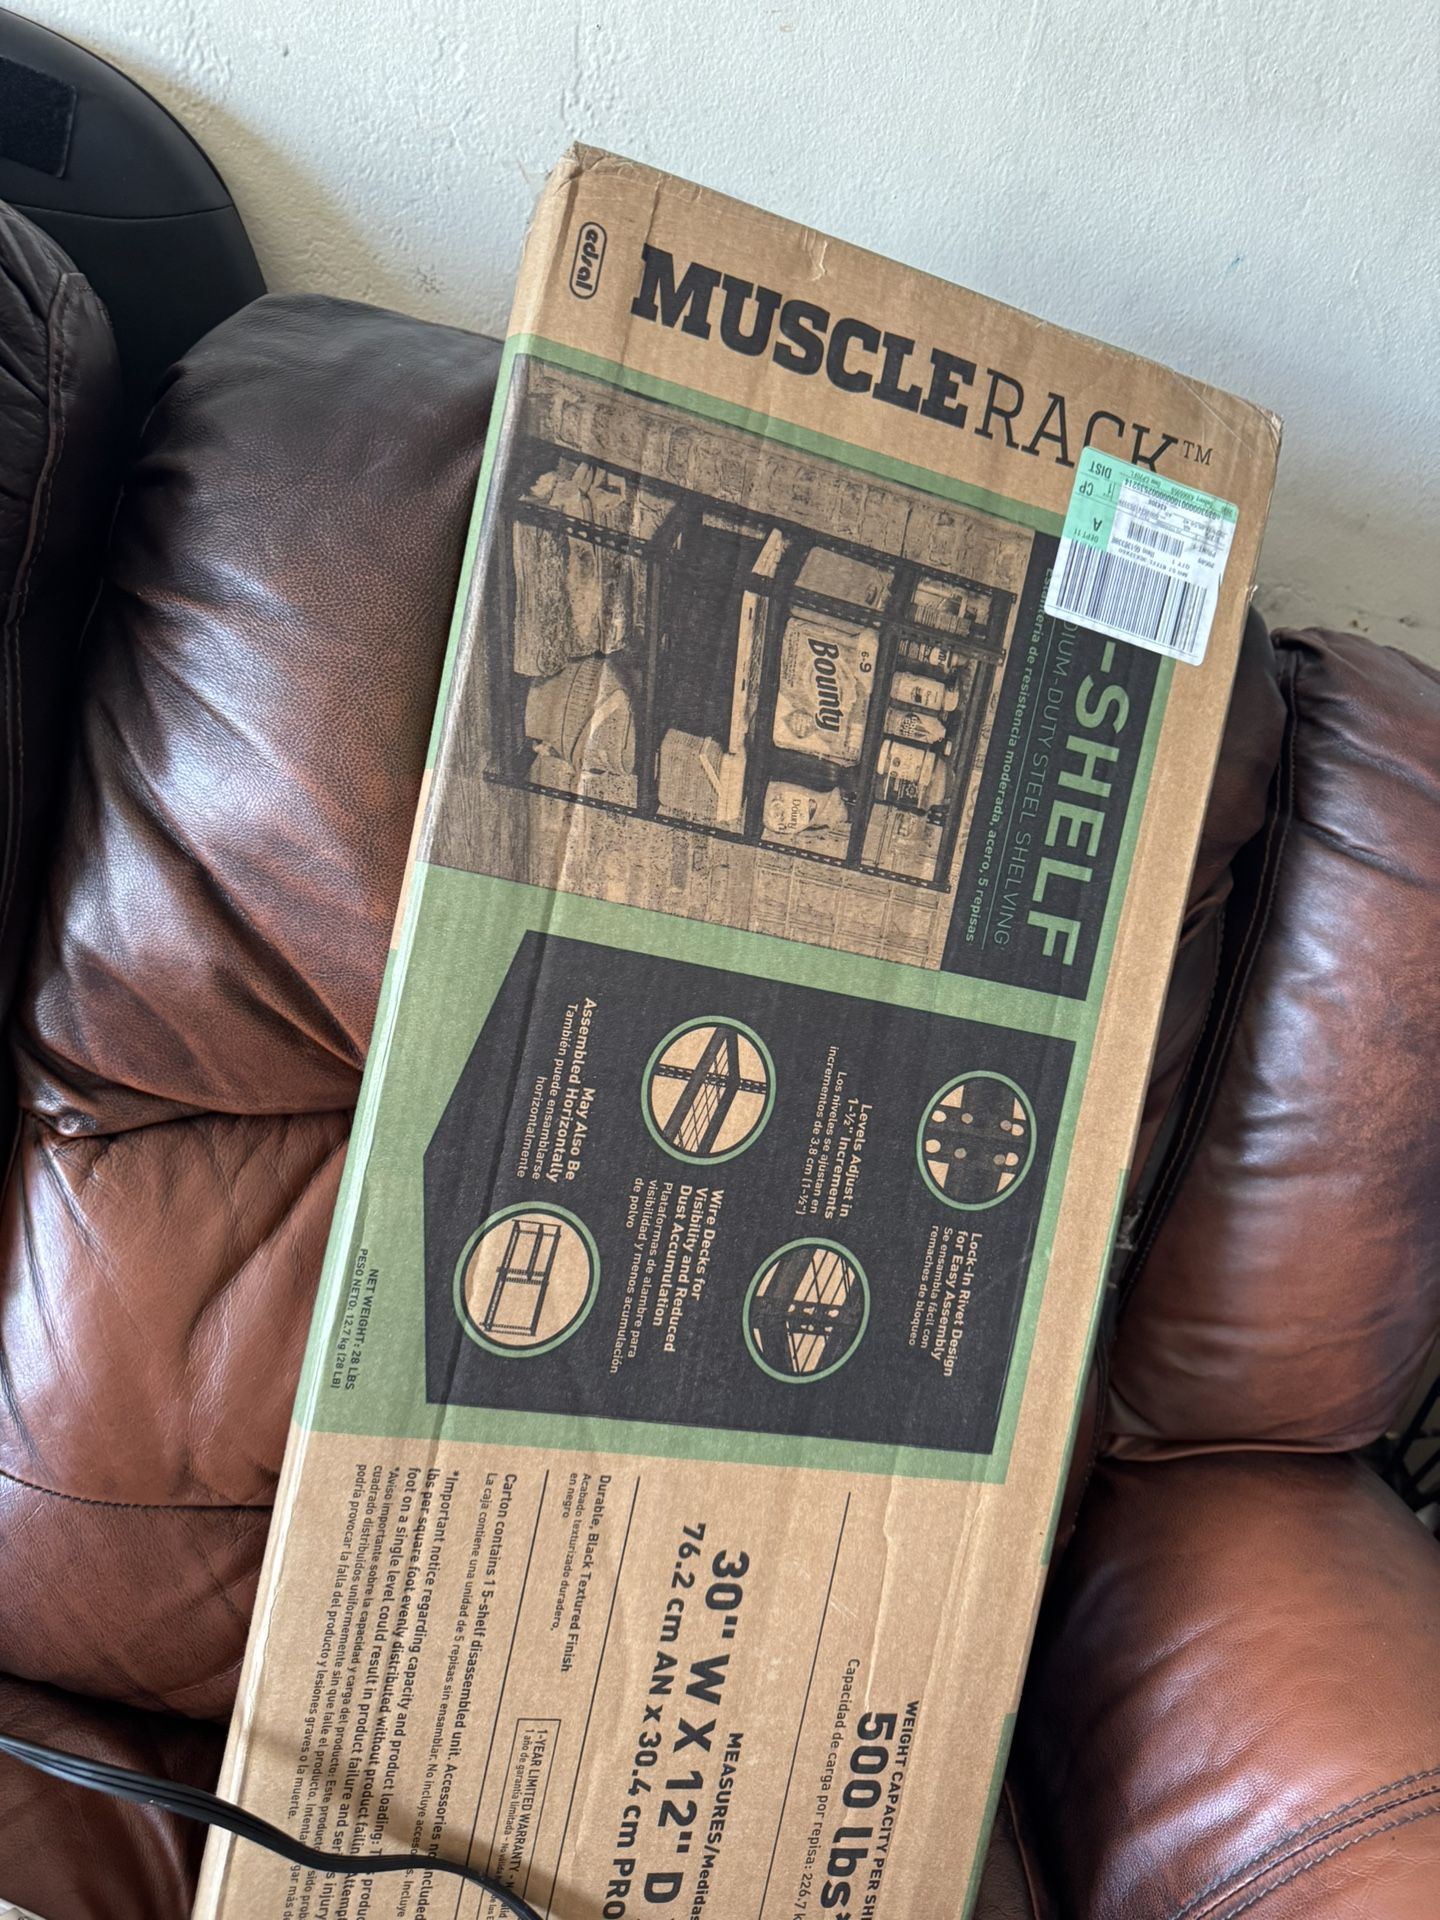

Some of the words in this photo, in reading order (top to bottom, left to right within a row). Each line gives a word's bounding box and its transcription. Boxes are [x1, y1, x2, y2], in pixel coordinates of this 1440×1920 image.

[1079, 481, 1094, 496] CP
[1088, 461, 1112, 480] DIST
[1093, 517, 1103, 532] A
[1026, 646, 1038, 664] de
[808, 638, 844, 732] Bounty
[1008, 667, 1032, 746] resistencia
[989, 750, 1014, 826] moderada,
[1019, 752, 1049, 823] STEEL
[1026, 640, 1129, 965] -SHELF
[978, 829, 996, 873] acero,
[977, 877, 989, 886] 5
[965, 889, 984, 941] repisas
[557, 1003, 578, 1056] También
[568, 997, 597, 1084] Assembled
[549, 1058, 564, 1096] puede
[816, 1045, 839, 1118] incrementos
[834, 1071, 847, 1092] Los
[576, 1087, 596, 1119] May
[825, 1094, 841, 1135] niveles
[516, 1075, 548, 1178] horizontalmente
[531, 1099, 555, 1180] ensamblarse
[545, 1087, 579, 1182] Horizontally
[570, 1121, 588, 1156] Also
[808, 1137, 820, 1155] 3.8
[812, 1120, 823, 1135] de
[822, 1137, 831, 1152] se
[853, 1103, 873, 1151] Levels
[565, 1160, 580, 1180] Be
[633, 1177, 644, 1192] de
[804, 1157, 814, 1175] cm
[813, 1154, 829, 1196] ajustan
[824, 1136, 851, 1219] Increments
[842, 1154, 862, 1200] Adjust
[625, 1195, 639, 1228] polvo
[637, 1179, 658, 1240] visibilidad
[649, 1182, 673, 1256] Plataformas
[674, 1184, 693, 1219] Dust
[682, 1187, 709, 1252] Visibility
[706, 1189, 724, 1225] Wire
[809, 1199, 819, 1213] en
[839, 1203, 852, 1217] in
[696, 1228, 716, 1274] Decks
[921, 1225, 939, 1281] remaches
[942, 1226, 953, 1242] Se
[955, 1230, 968, 1252] for
[365, 1268, 379, 1293] NET
[626, 1253, 642, 1293] menos
[645, 1258, 657, 1274] de
[652, 1222, 684, 1326] Accumulation
[677, 1255, 692, 1283] and
[930, 1244, 947, 1299] ensambla
[945, 1254, 963, 1288] Easy
[961, 1232, 982, 1286] Lock-In
[634, 1276, 652, 1327] alambre
[691, 1278, 705, 1301] for
[918, 1283, 928, 1298] de
[953, 1289, 971, 1326] Rivet
[353, 1295, 373, 1347] WEIGHT:
[609, 1296, 633, 1373] acumulación
[663, 1287, 688, 1352] Reduced
[908, 1300, 925, 1346] bloqueo
[925, 1301, 938, 1325] fácil
[930, 1290, 955, 1360] Assembly
[350, 1349, 362, 1364] 28
[627, 1330, 640, 1358] para
[920, 1328, 930, 1348] con
[943, 1328, 963, 1376] Design
[344, 1367, 358, 1390] LBS
[404, 1467, 421, 1492] foot
[424, 1467, 440, 1489] lbs
[497, 1473, 517, 1518] Carton
[575, 1473, 592, 1517] Acabado
[398, 1515, 408, 1523] a
[400, 1495, 412, 1512] on
[420, 1491, 432, 1513] per
[588, 1474, 612, 1529] Durable,
[388, 1526, 408, 1567] single
[409, 1516, 427, 1562] square
[485, 1521, 505, 1576] contains
[562, 1519, 582, 1578] texturizado
[582, 1533, 600, 1569] Black
[671, 1522, 706, 1588] 76.2
[381, 1570, 400, 1602] level
[403, 1566, 420, 1592] foot
[424, 1545, 441, 1585] notice
[391, 1594, 411, 1637] evenly
[473, 1590, 494, 1637] 5-shelf
[550, 1579, 570, 1631] duradero,
[569, 1572, 592, 1630] Textured
[704, 1549, 750, 1639] 30"
[374, 1605, 390, 1641] could
[408, 1588, 433, 1653] regarding
[659, 1597, 684, 1642] cm
[365, 1645, 382, 1684] result
[560, 1633, 579, 1672] Finish
[648, 1650, 678, 1695] AN
[362, 1687, 373, 1700] in
[378, 1640, 404, 1713] distributed
[396, 1656, 418, 1710] capacity
[454, 1639, 483, 1728] disassembled
[685, 1654, 730, 1705] W
[834, 1658, 860, 1728] Capacidad
[351, 1703, 370, 1753] product
[393, 1712, 407, 1736] and
[642, 1704, 663, 1723] x
[672, 1717, 717, 1753] X
[894, 1700, 919, 1767] WEIGHT
[368, 1716, 386, 1766] without
[447, 1731, 462, 1760] unit.
[530, 1729, 548, 1766] 1-YEAR
[830, 1731, 844, 1749] de
[842, 1711, 898, 1808] 500
[382, 1740, 402, 1789] product
[627, 1731, 662, 1796] 30.4
[820, 1752, 837, 1791] carga
[357, 1769, 376, 1819] product
[431, 1763, 458, 1840] Accessories
[521, 1769, 540, 1811] LIMITED
[657, 1770, 704, 1853] 12"
[815, 1795, 828, 1818] por
[369, 1793, 393, 1844] loading:
[616, 1804, 641, 1848] cm
[876, 1771, 904, 1853] CAPACITY
[509, 1813, 531, 1872] WARRANTY
[804, 1822, 823, 1869] repisa:
[643, 1871, 684, 1903] D
[795, 1872, 813, 1909] 226.7
[867, 1857, 885, 1890] PER
